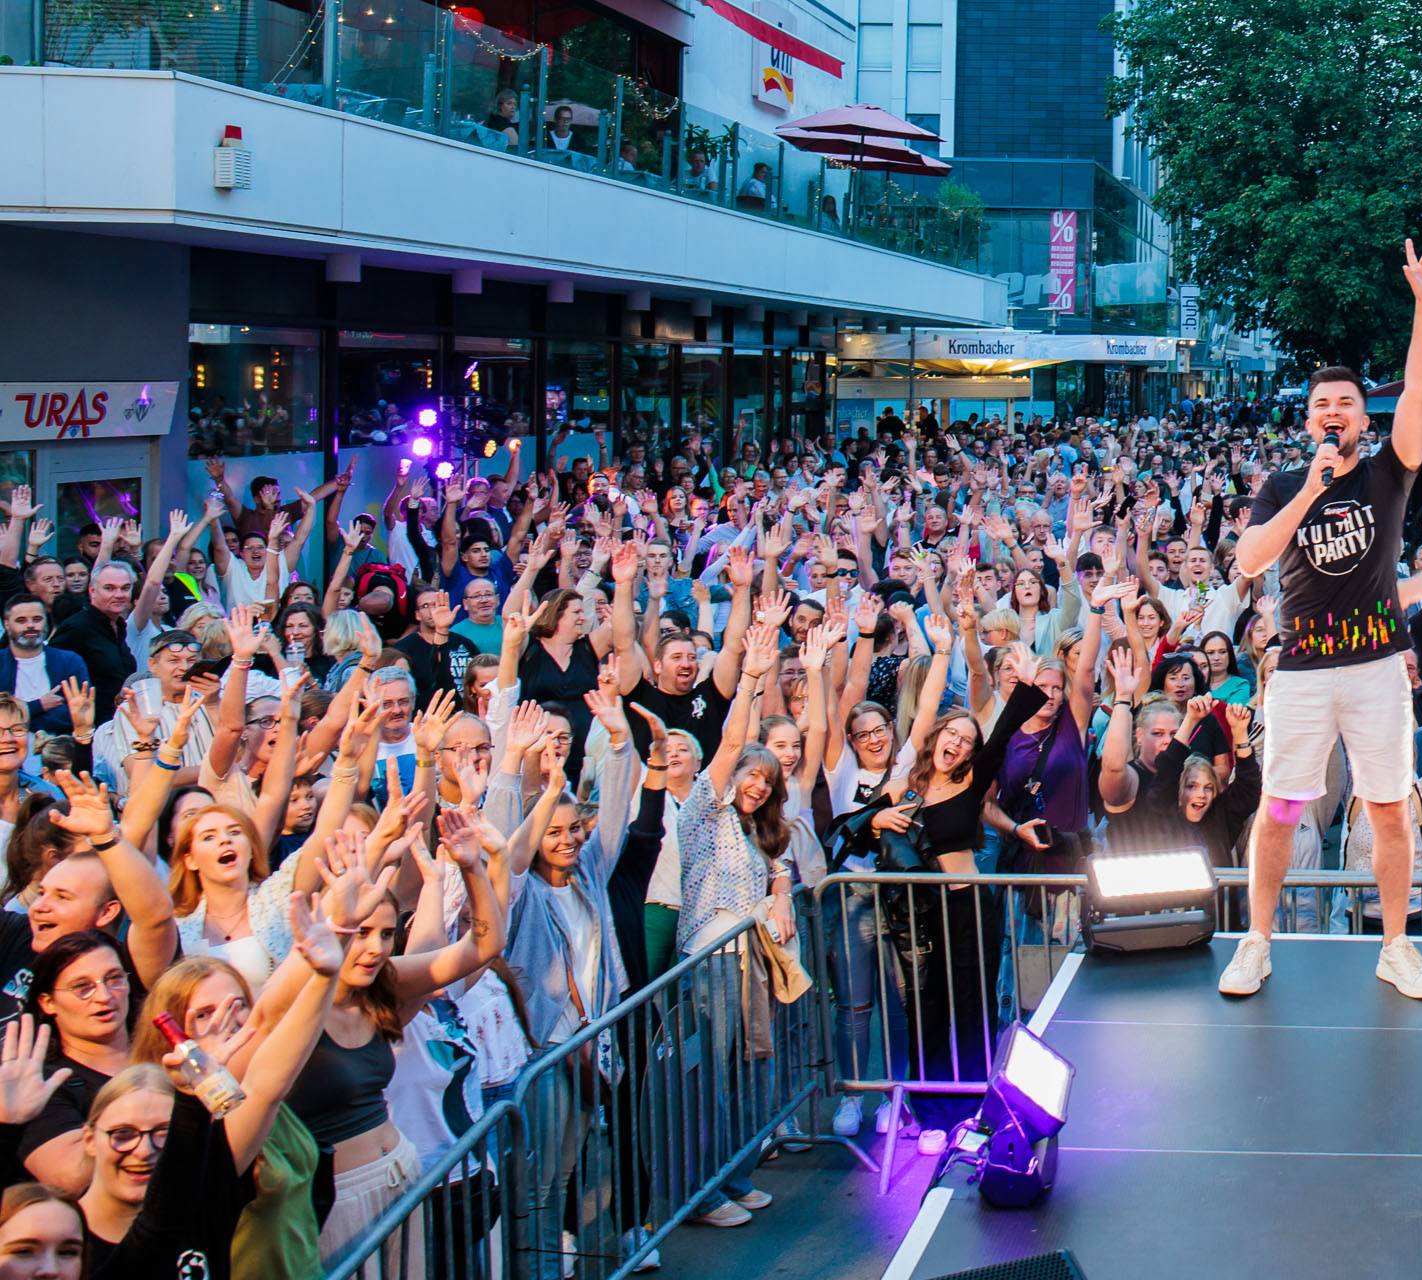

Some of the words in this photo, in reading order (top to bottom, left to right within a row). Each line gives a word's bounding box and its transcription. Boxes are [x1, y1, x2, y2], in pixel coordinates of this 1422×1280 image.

[948, 339, 1015, 355] Krombacher
[1106, 339, 1147, 355] Krombacher
[1314, 528, 1367, 566] PARTY
